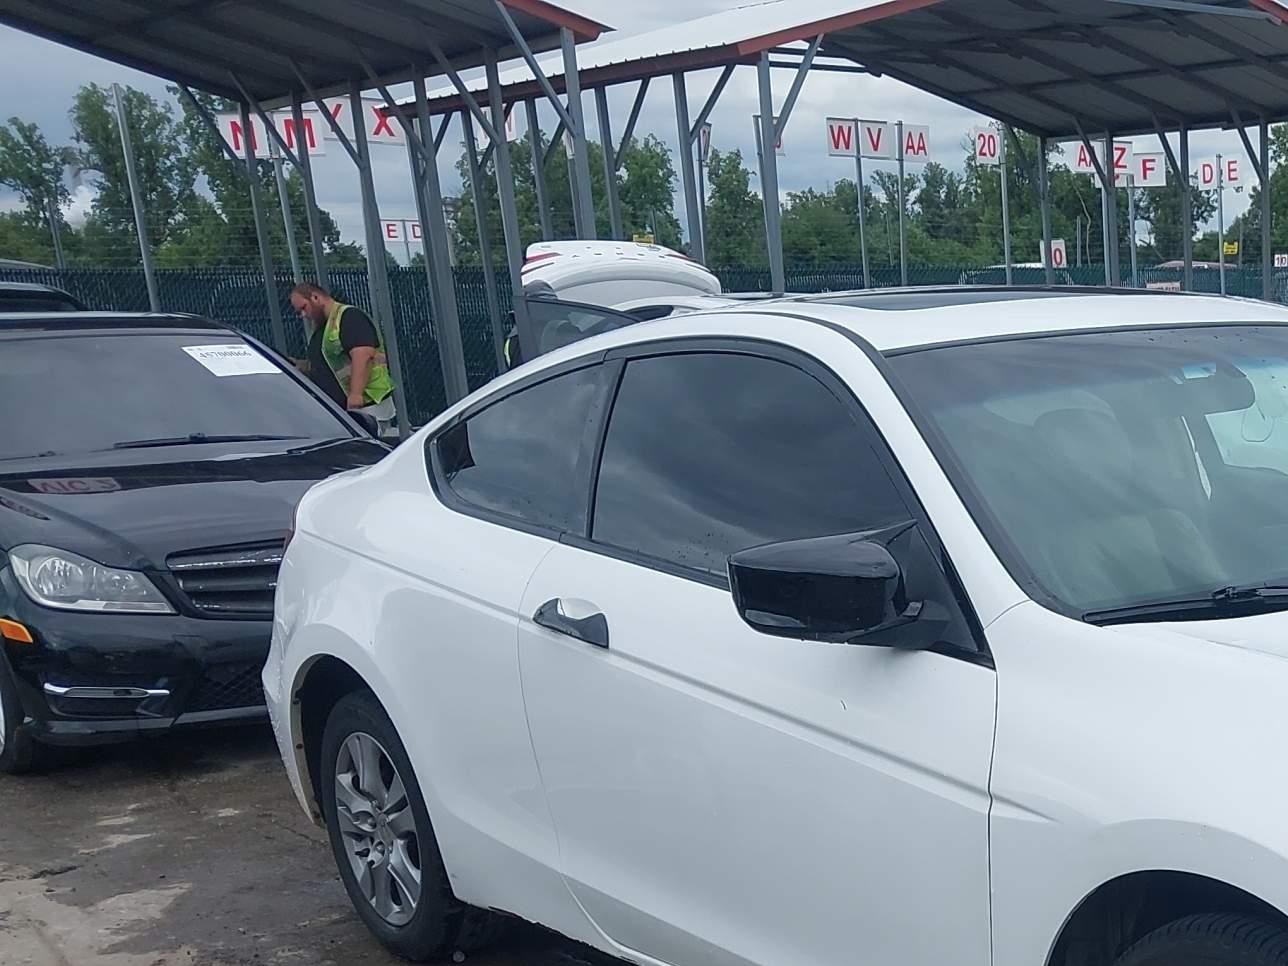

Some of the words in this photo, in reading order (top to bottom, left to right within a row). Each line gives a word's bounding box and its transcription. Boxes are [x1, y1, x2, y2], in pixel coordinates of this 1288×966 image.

[372, 105, 396, 137] X
[829, 124, 852, 151] W
[866, 127, 882, 152] V
[905, 131, 928, 156] AA
[977, 133, 997, 158] 20
[1114, 147, 1128, 169] Z
[1141, 158, 1156, 180] F
[1202, 163, 1214, 184] D
[1227, 160, 1239, 182] E
[386, 223, 399, 239] E
